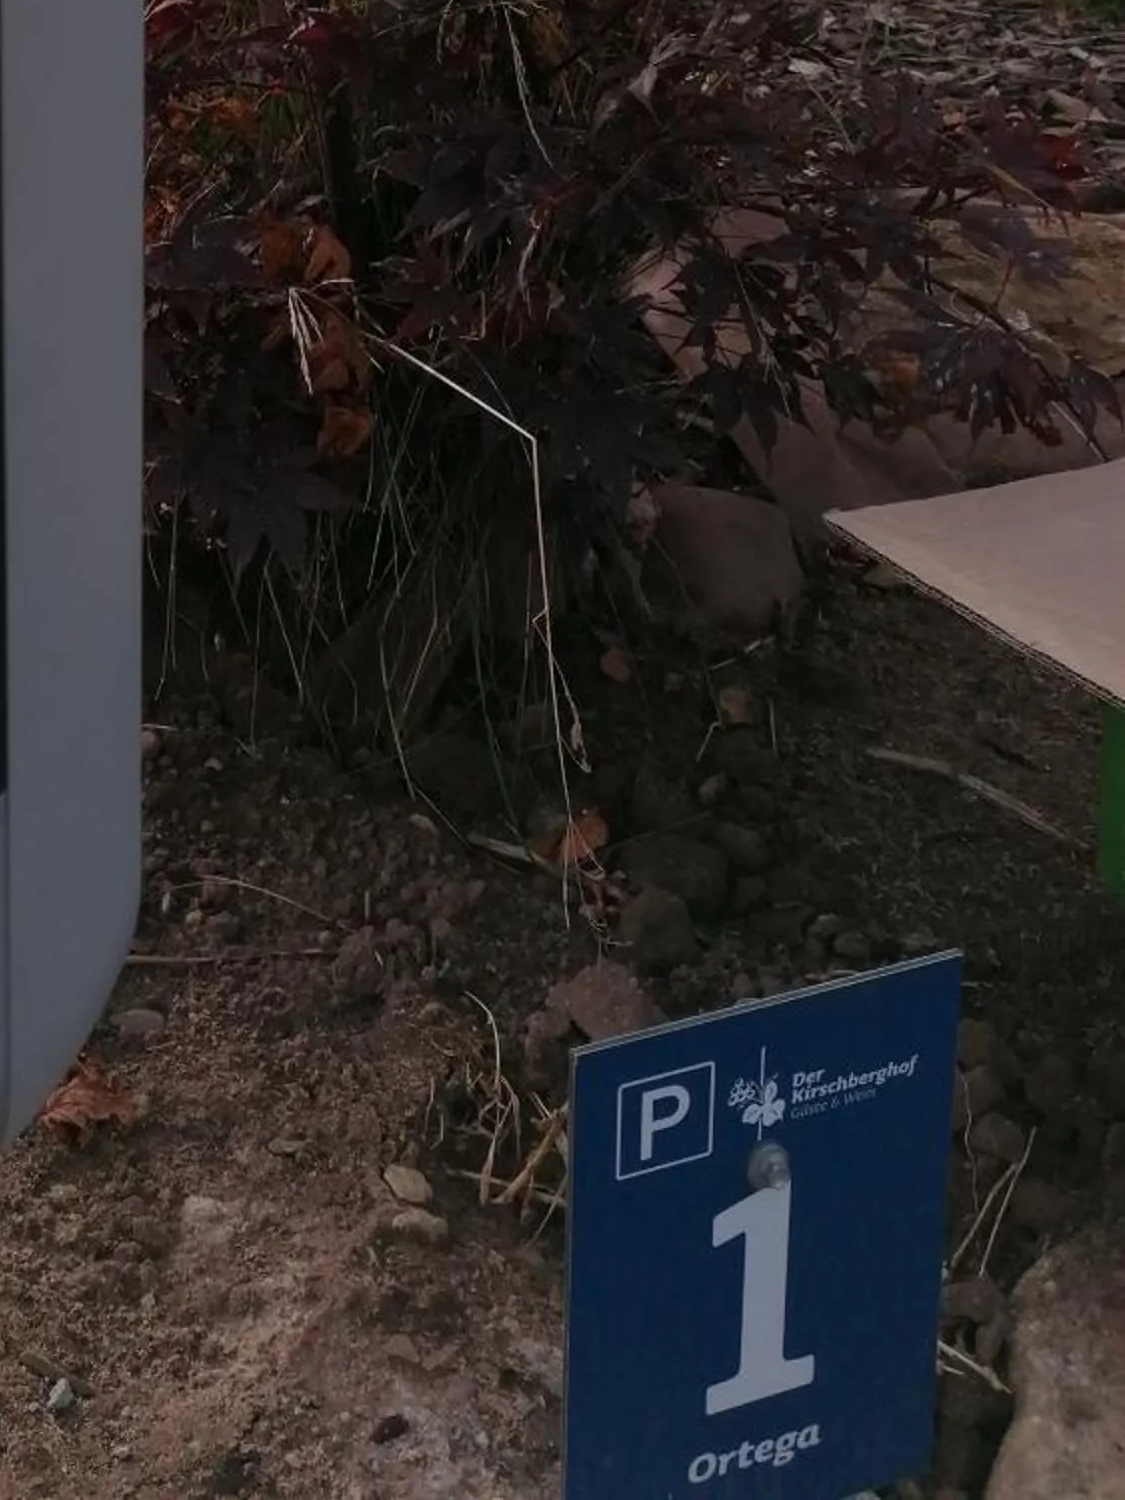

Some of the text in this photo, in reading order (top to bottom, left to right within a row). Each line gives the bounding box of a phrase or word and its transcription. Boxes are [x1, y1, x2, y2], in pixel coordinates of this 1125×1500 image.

[791, 1068, 826, 1088] Der
[791, 1053, 920, 1104] Kirschberghof
[639, 1084, 690, 1161] P
[705, 1176, 815, 1416] 1
[687, 1422, 822, 1485] Ortega
